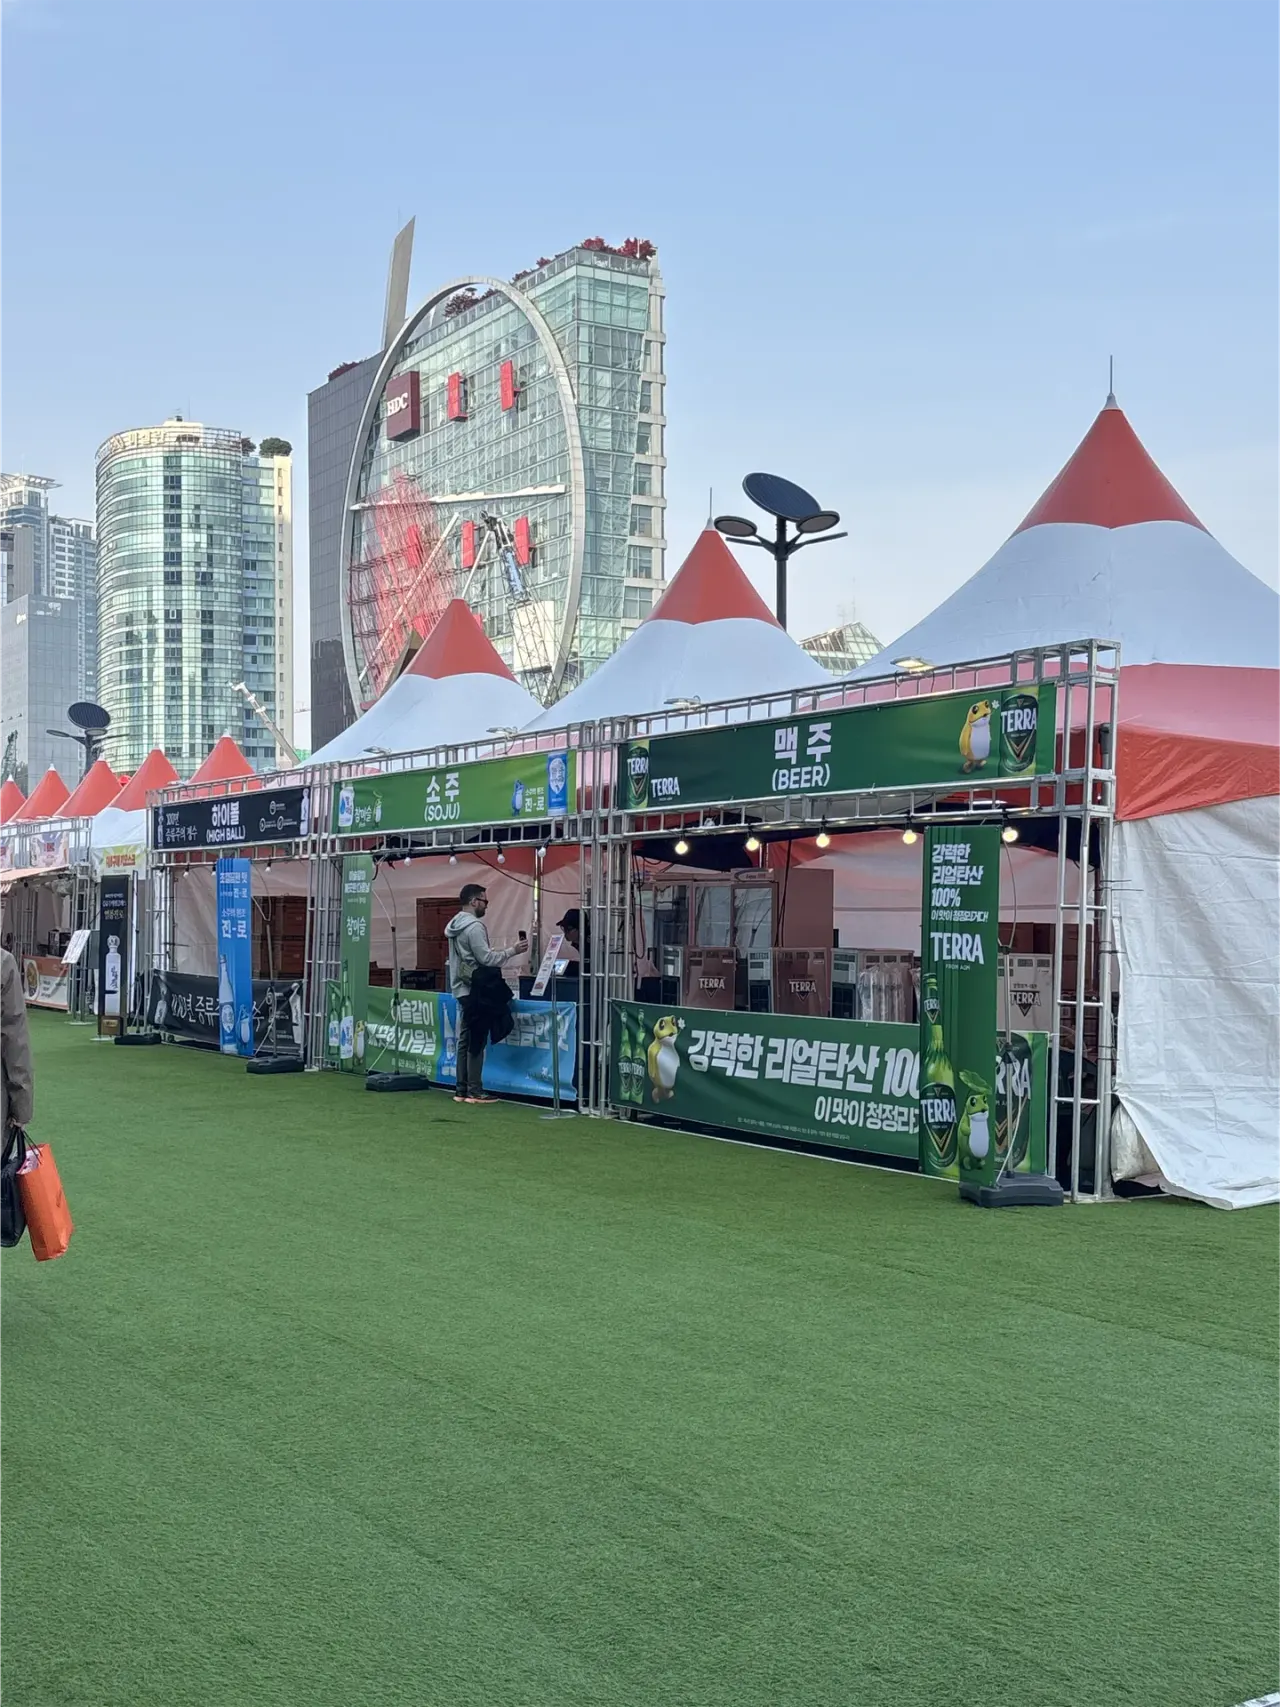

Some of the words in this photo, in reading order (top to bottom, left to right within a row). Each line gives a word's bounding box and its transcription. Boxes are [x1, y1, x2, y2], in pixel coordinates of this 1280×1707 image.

[1001, 708, 1037, 734] TERRA
[627, 757, 648, 776] TERRA
[651, 777, 680, 798] TERRA
[771, 763, 831, 792] (BEER)
[211, 801, 240, 827] 하이볼
[354, 805, 372, 822] 참이슬
[424, 802, 460, 822] (SOJU)
[206, 829, 226, 843] (HIGH
[226, 826, 246, 841] BALL)
[932, 843, 971, 863] 강력한
[932, 865, 984, 885] 리얼탄산
[931, 888, 961, 907] 100%
[346, 916, 366, 936] 참이슬
[930, 932, 985, 965] TERRA
[698, 978, 725, 989] TERRA
[788, 981, 817, 992] TERRA
[924, 999, 940, 1012] TERRA
[1010, 991, 1041, 1006] TERRA
[687, 1029, 764, 1080] 강력한
[765, 1038, 880, 1094] 리얼탄산
[920, 1098, 957, 1124] TERRA
